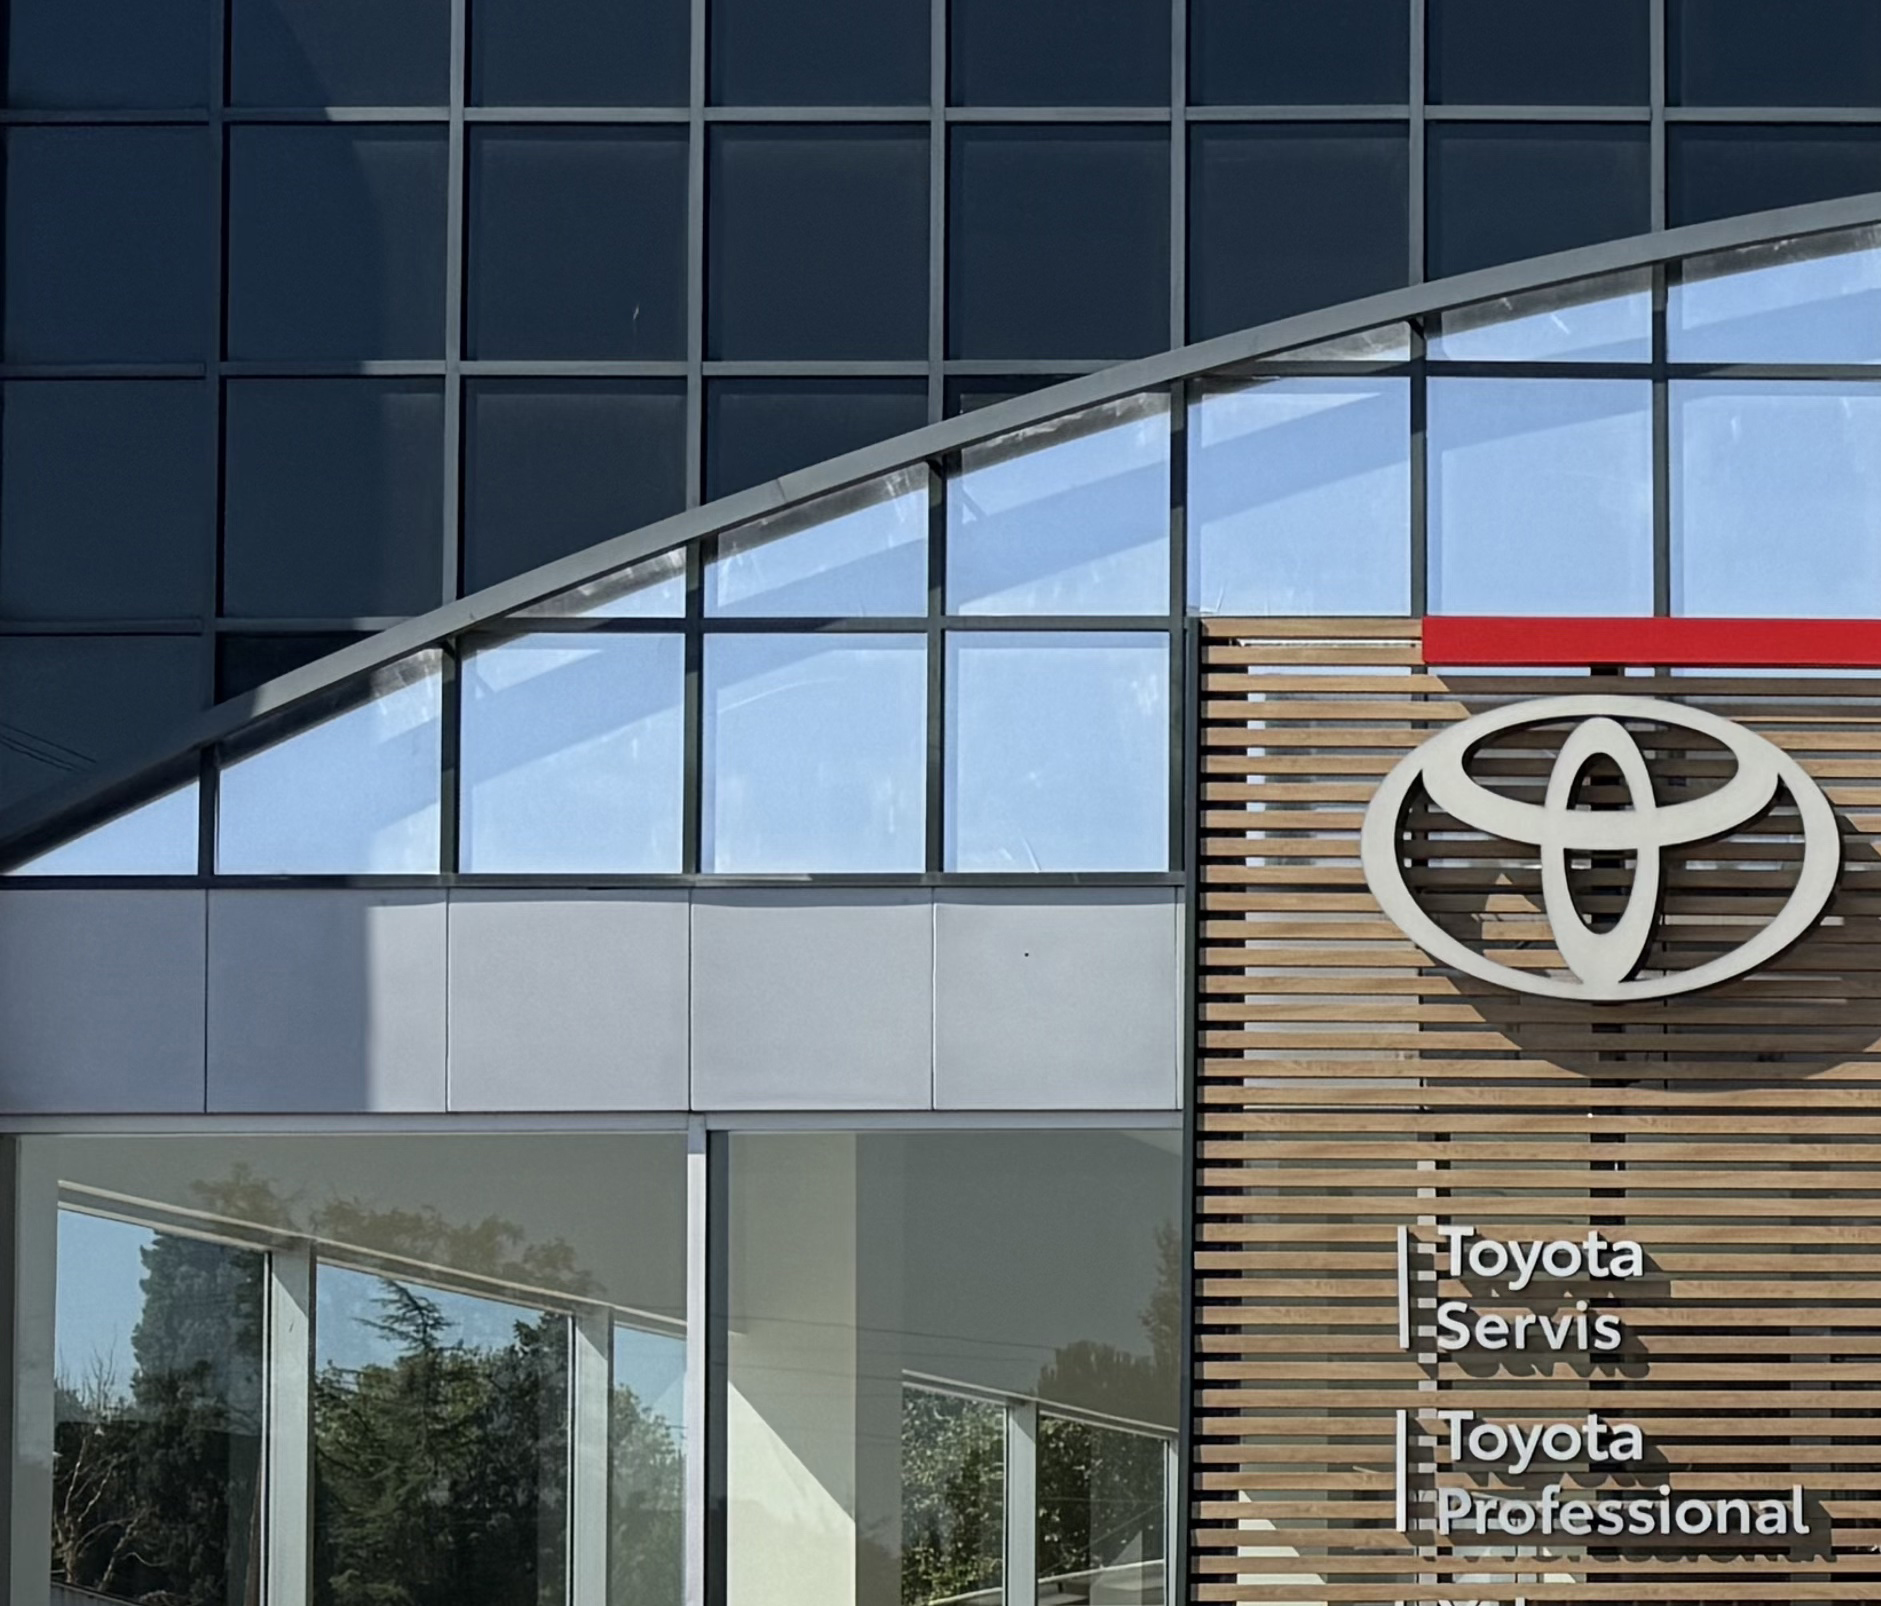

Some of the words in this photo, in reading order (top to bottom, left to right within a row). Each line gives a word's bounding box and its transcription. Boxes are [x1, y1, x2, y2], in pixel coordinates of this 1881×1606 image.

[1437, 1225, 1645, 1291] Toyota
[1436, 1299, 1622, 1351] Servis
[1437, 1409, 1644, 1475] Toyota
[1437, 1483, 1811, 1536] Professional
